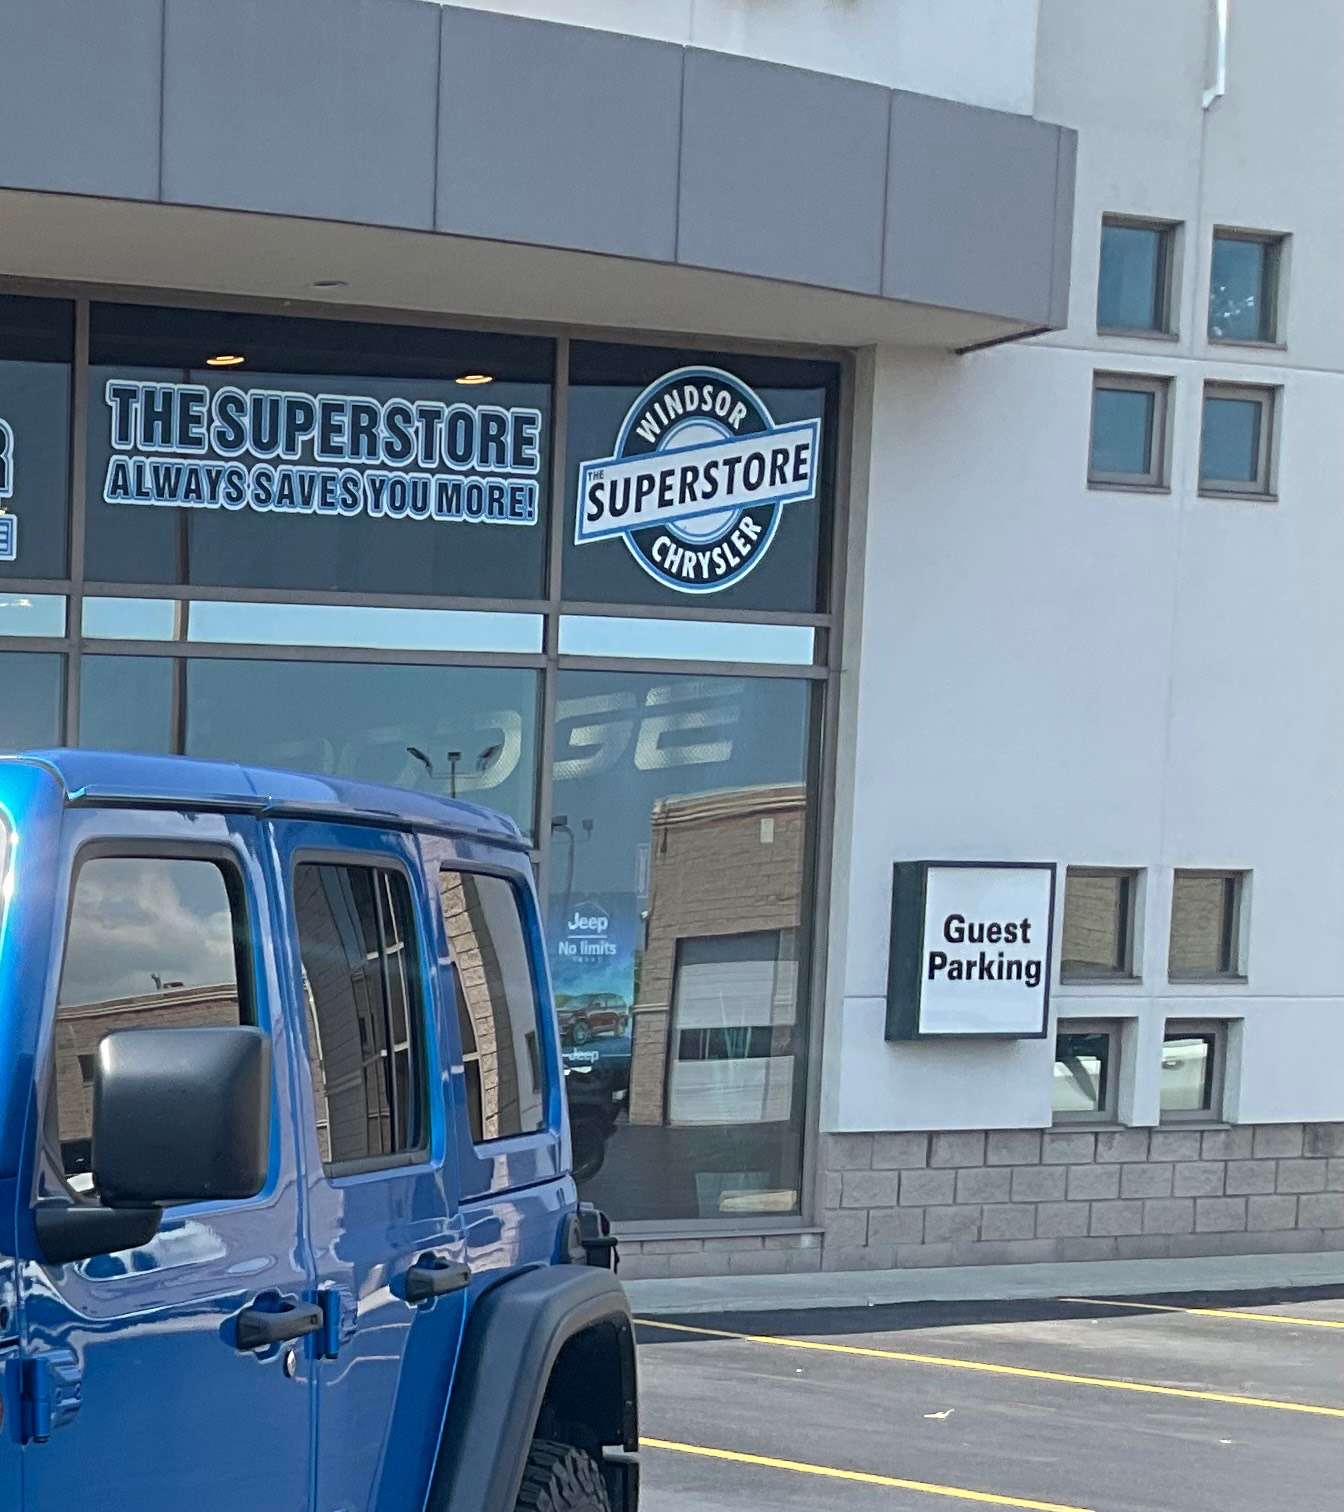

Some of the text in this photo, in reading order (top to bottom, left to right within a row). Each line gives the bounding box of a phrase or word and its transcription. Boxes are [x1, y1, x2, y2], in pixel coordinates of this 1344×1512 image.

[110, 385, 540, 470] THE SUPERSTORE
[635, 384, 748, 444] WINDSOR
[111, 461, 535, 519] ALWAYS SAVES YOU MORE!
[586, 442, 811, 522] SUPERSTORE
[588, 470, 605, 482] THE
[651, 515, 762, 579] CHRYSLER
[568, 912, 609, 933] Jeep
[943, 914, 1032, 944] Guest
[558, 941, 617, 956] No limits
[928, 951, 1042, 988] Parking
